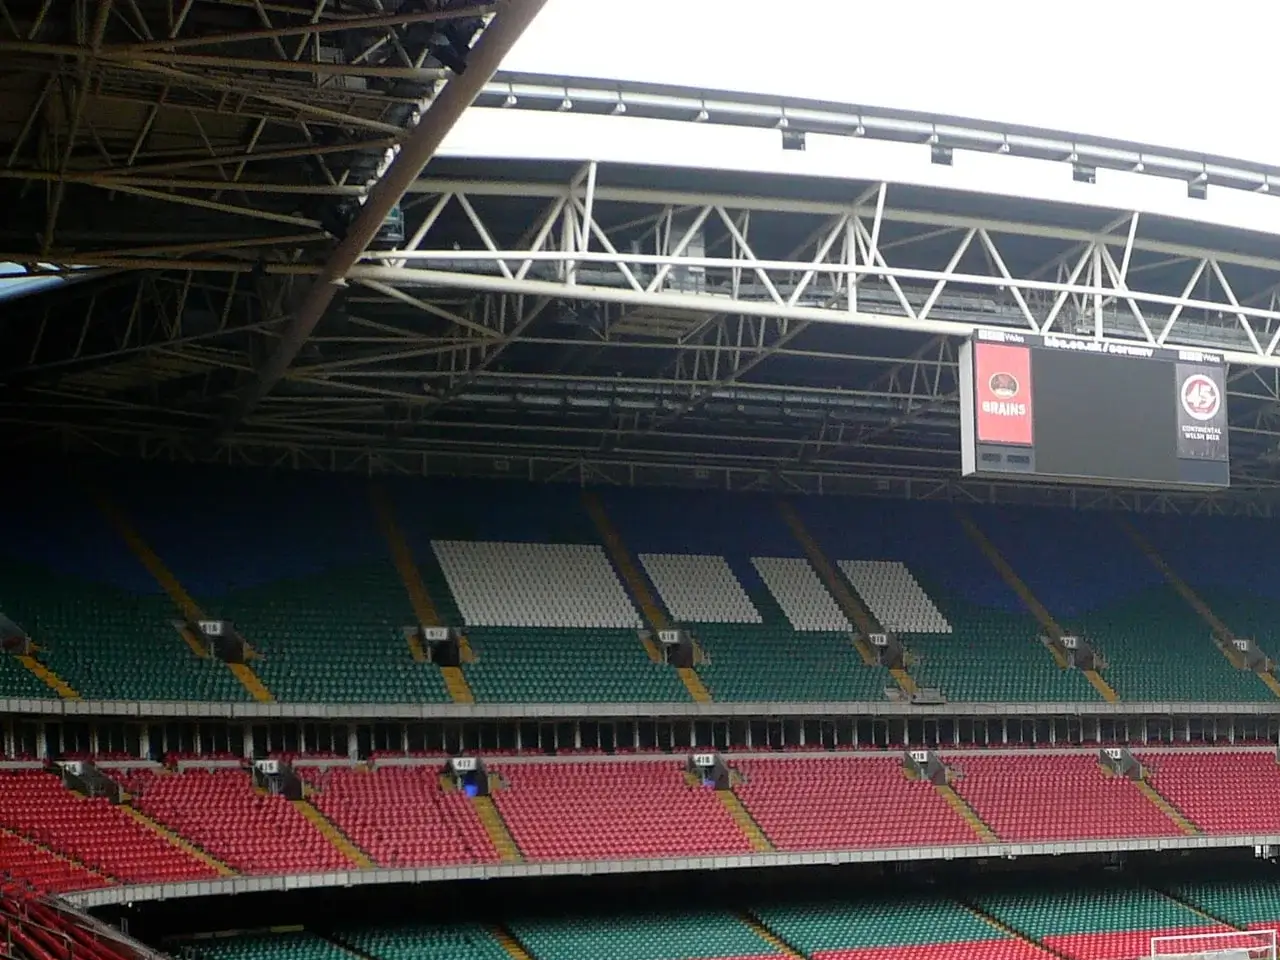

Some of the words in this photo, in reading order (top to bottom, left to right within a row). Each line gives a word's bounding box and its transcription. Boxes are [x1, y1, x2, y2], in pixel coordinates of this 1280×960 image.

[1186, 382, 1216, 408] 45
[981, 401, 1026, 417] BRAINS
[1184, 432, 1205, 440] WELSH
[1206, 433, 1220, 441] BEER
